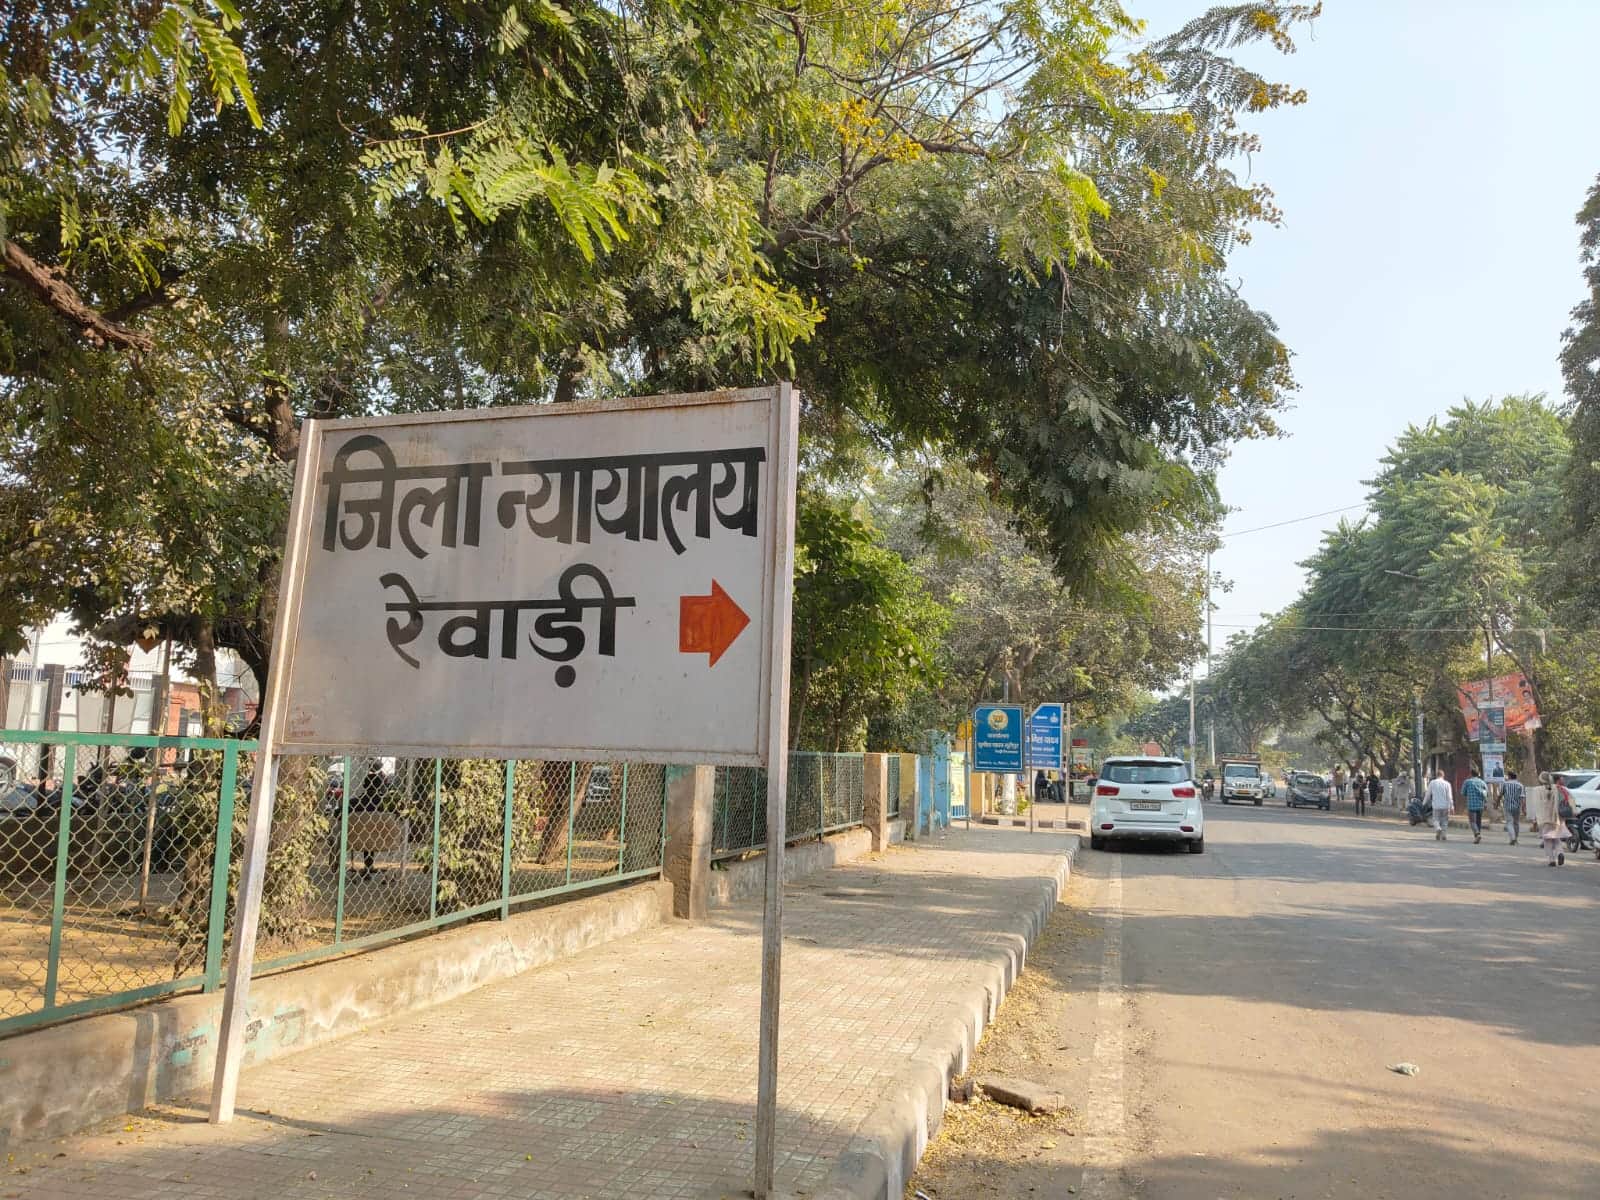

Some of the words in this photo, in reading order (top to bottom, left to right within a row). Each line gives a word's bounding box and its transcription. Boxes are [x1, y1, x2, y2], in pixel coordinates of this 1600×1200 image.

[322, 435, 492, 559] जिला
[497, 446, 766, 555] न्यायालय
[379, 562, 636, 689] रेवाड़ी
